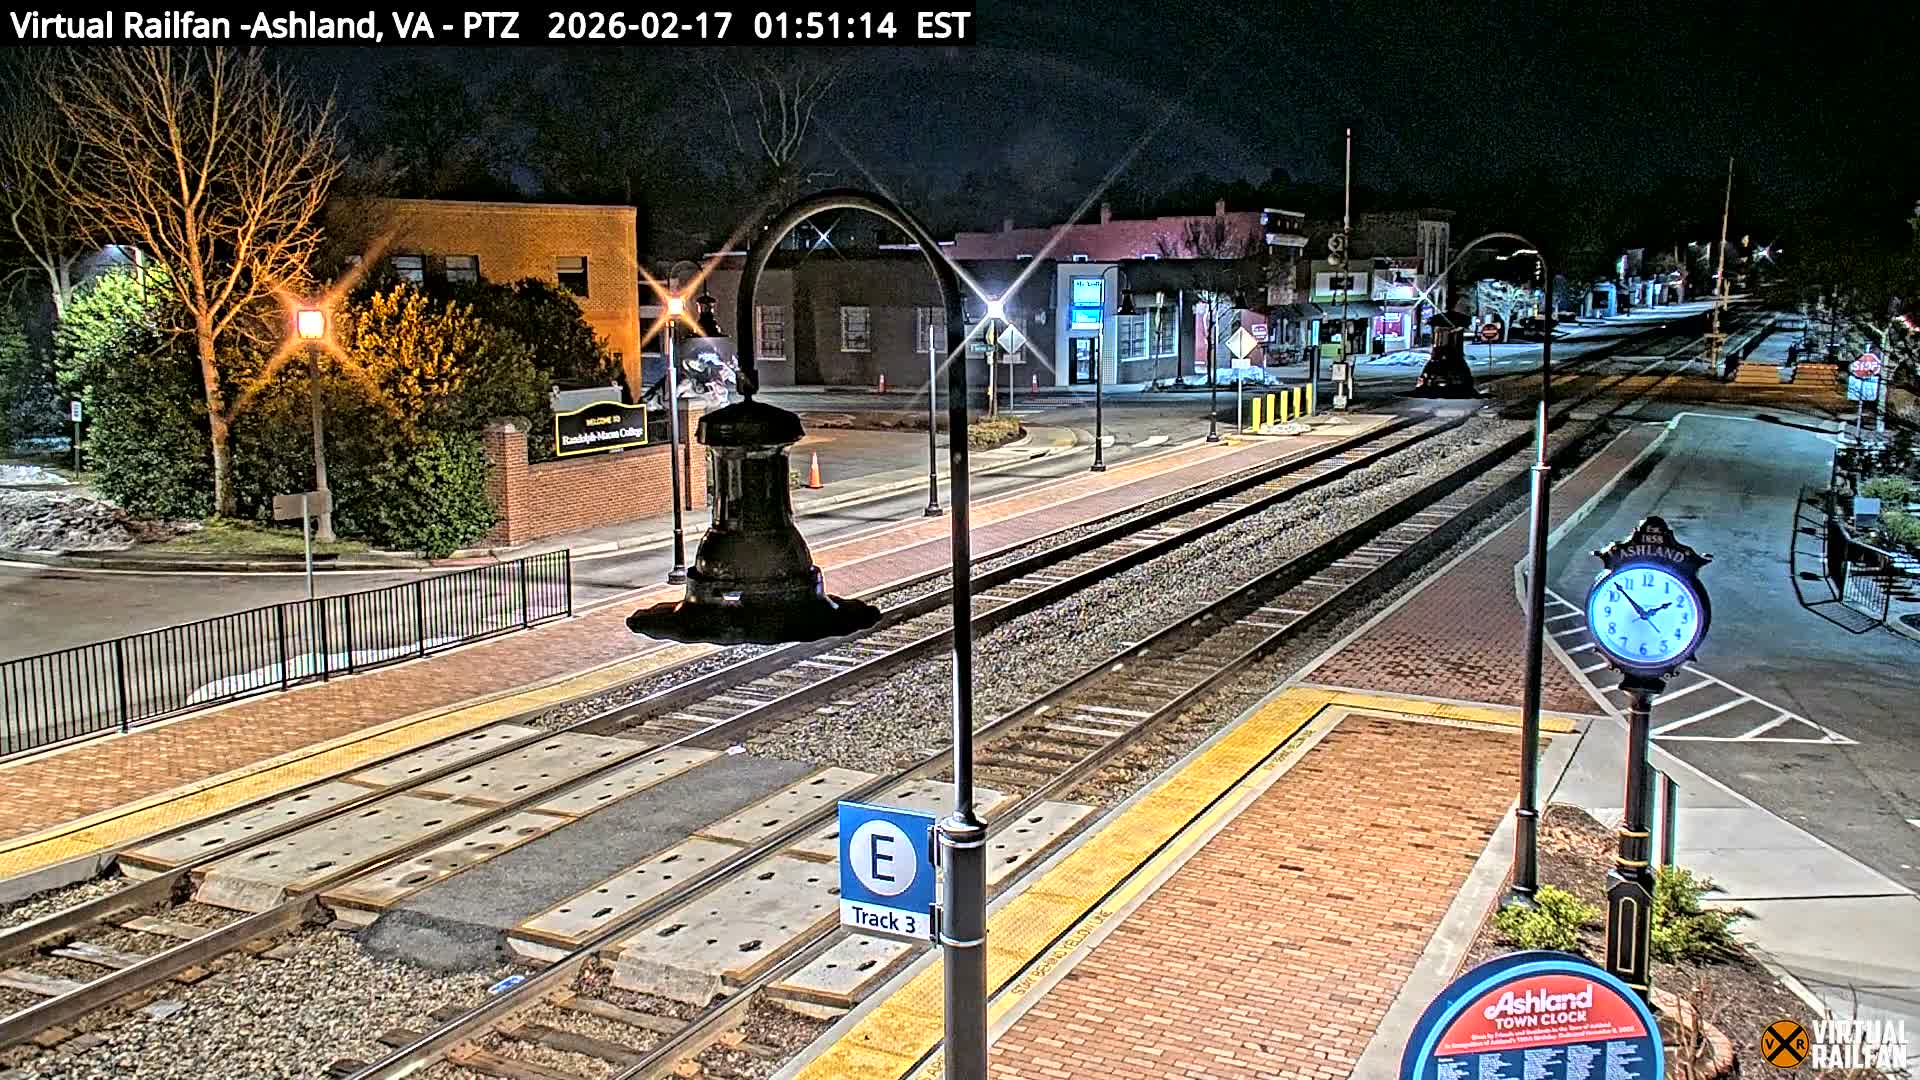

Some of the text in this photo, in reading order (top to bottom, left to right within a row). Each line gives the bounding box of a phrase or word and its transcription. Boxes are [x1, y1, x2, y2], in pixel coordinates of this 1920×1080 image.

[1853, 360, 1879, 371] STOP
[1619, 547, 1684, 562] ASHLAND
[1624, 577, 1635, 591] 11
[1641, 574, 1655, 587] 12
[1664, 582, 1670, 594] 1
[1609, 590, 1621, 604] 10
[1675, 596, 1685, 609] 2
[1604, 606, 1612, 619] 9
[1680, 612, 1689, 625] 3
[1607, 622, 1617, 635] 8
[1674, 628, 1682, 641] 4
[1618, 636, 1628, 649] 7
[1639, 642, 1648, 656] 6
[1659, 640, 1669, 653] 5
[870, 833, 896, 882] E
[851, 906, 916, 934] Track 3
[1484, 984, 1592, 1019] Ashland
[1495, 1014, 1538, 1030] TOWN
[1540, 1010, 1587, 1026] CLOCK
